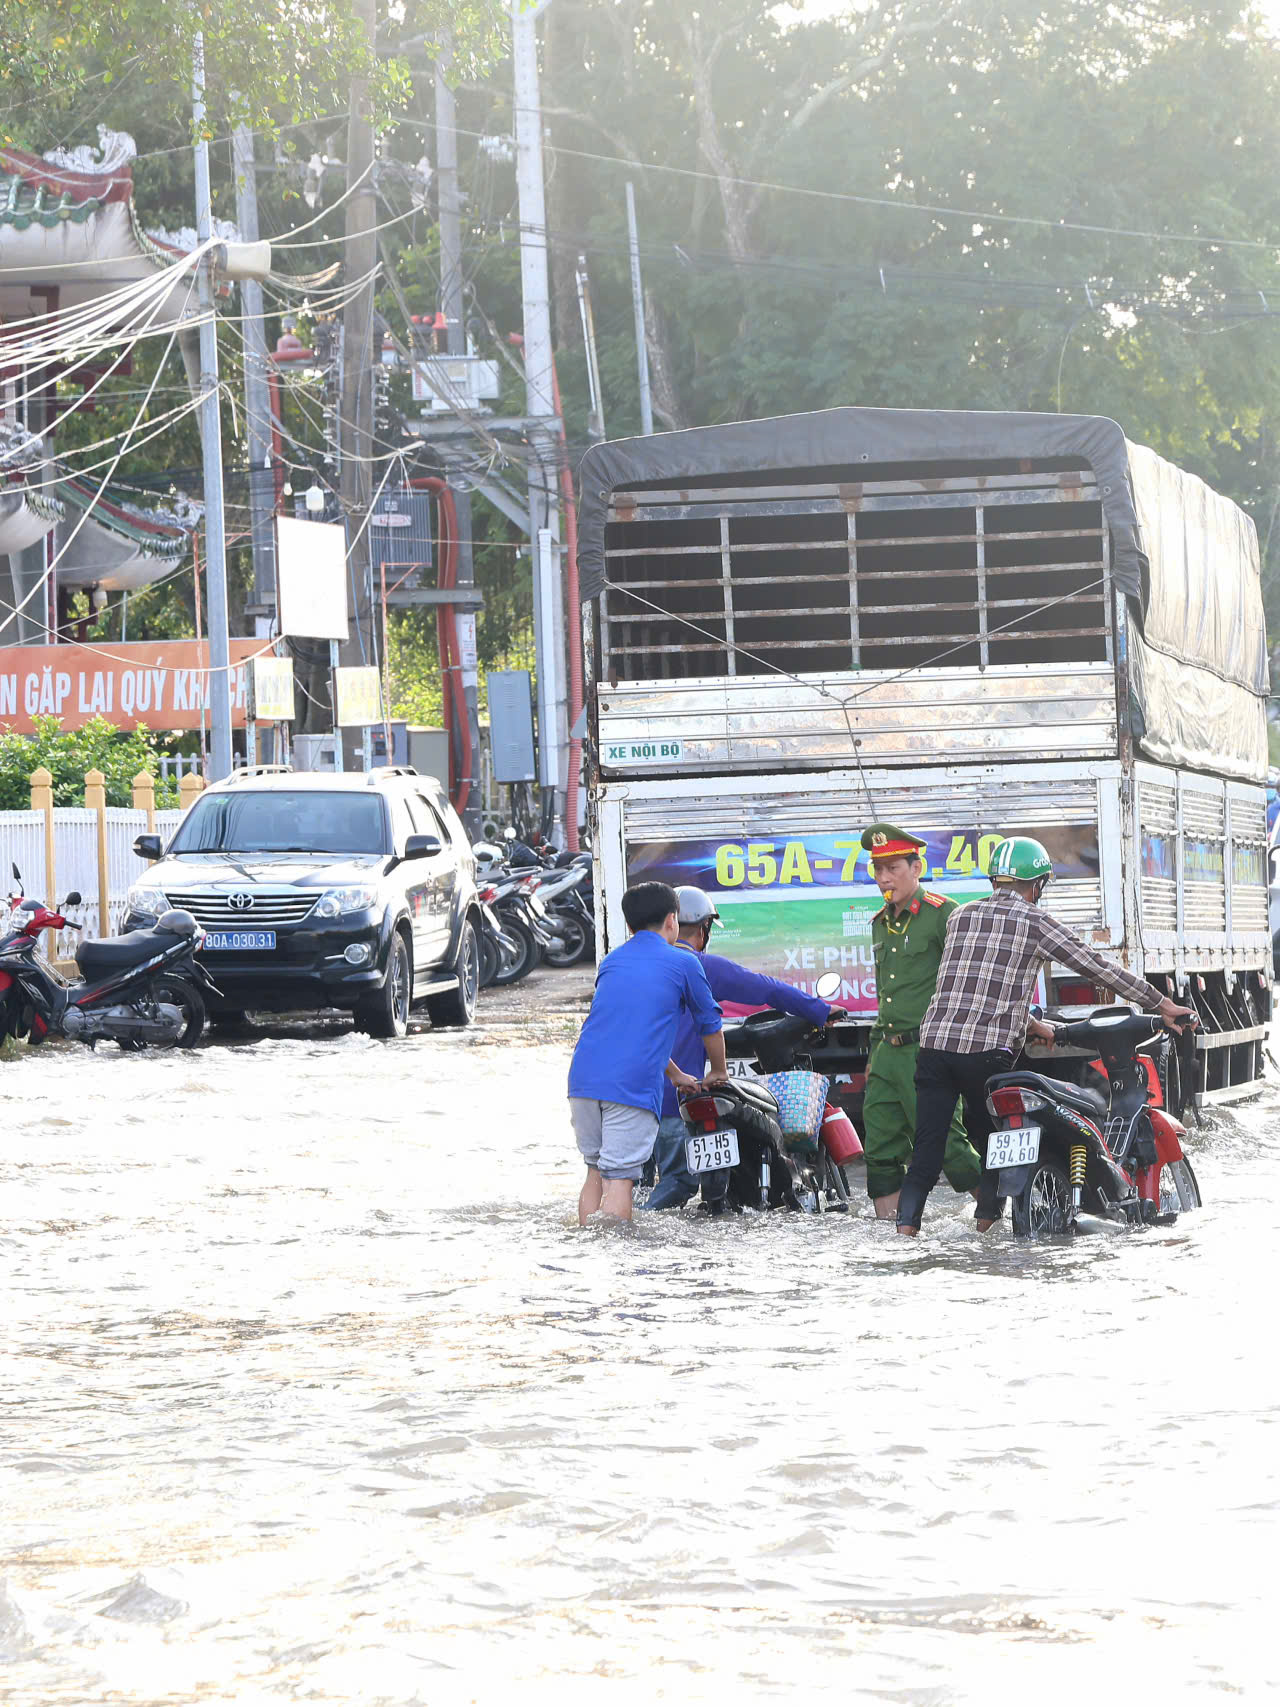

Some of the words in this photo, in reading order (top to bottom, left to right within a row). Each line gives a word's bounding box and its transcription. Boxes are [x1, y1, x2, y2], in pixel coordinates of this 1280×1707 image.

[121, 656, 167, 717] QUÝ
[609, 747, 627, 759] XE
[631, 743, 656, 760] NỘI
[661, 742, 679, 759] BỘ
[715, 833, 1008, 887] 65A-7.40
[205, 933, 274, 948] 80A-030.31
[783, 946, 816, 970] XE
[726, 1061, 747, 1077] 5A
[693, 1133, 730, 1154] 51-H5
[996, 1131, 1031, 1150] 59-Y1
[694, 1149, 732, 1171] 7299
[989, 1146, 1036, 1167] 294.60
